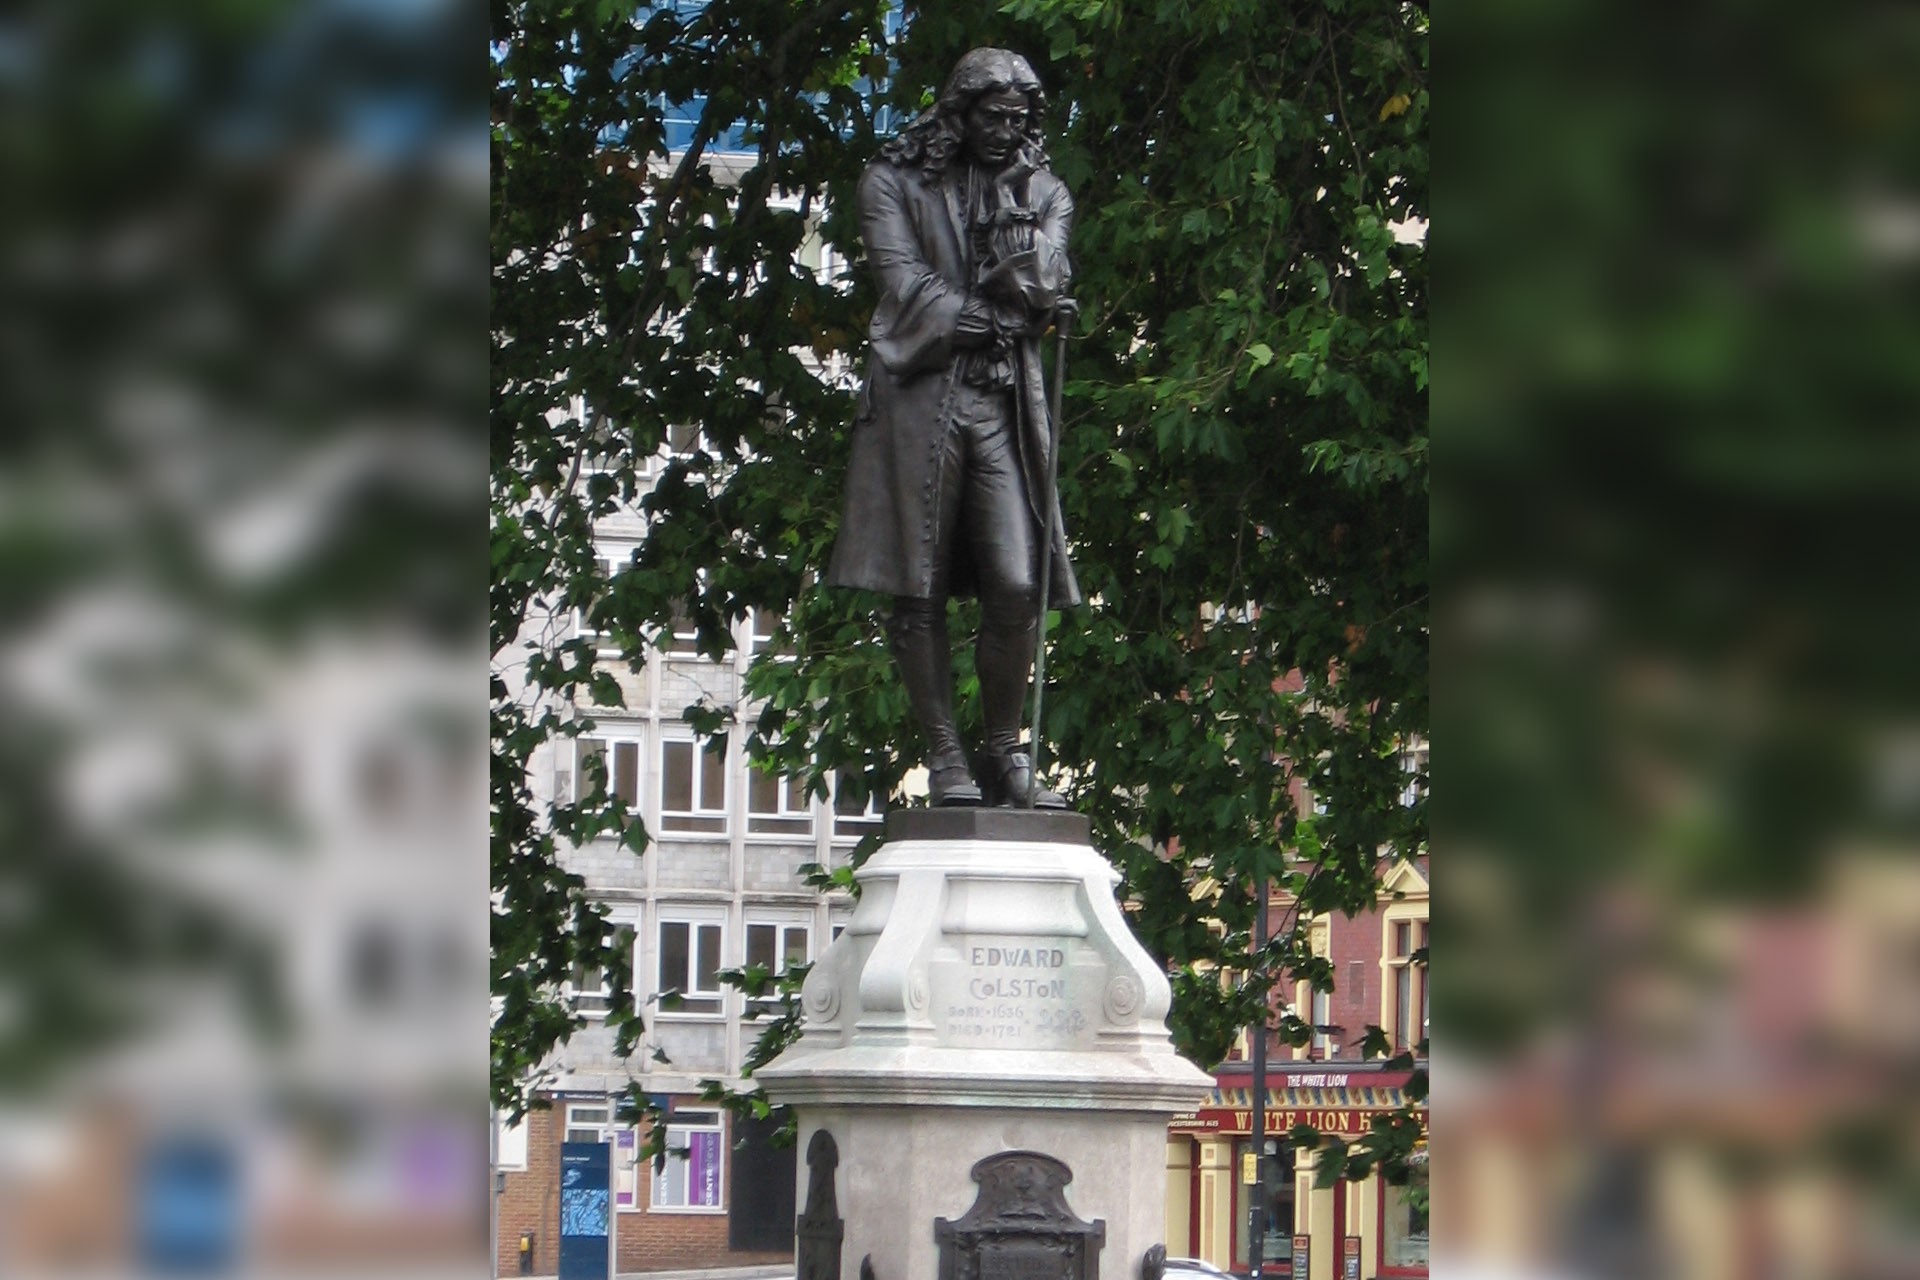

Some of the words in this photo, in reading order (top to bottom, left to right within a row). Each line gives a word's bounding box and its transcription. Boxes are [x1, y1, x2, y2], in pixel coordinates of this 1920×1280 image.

[971, 947, 1064, 968] EDWARD
[1287, 1074, 1302, 1087] THE
[1302, 1074, 1326, 1087] WHITE
[1327, 1074, 1348, 1087] LION
[1234, 1111, 1296, 1131] WITE
